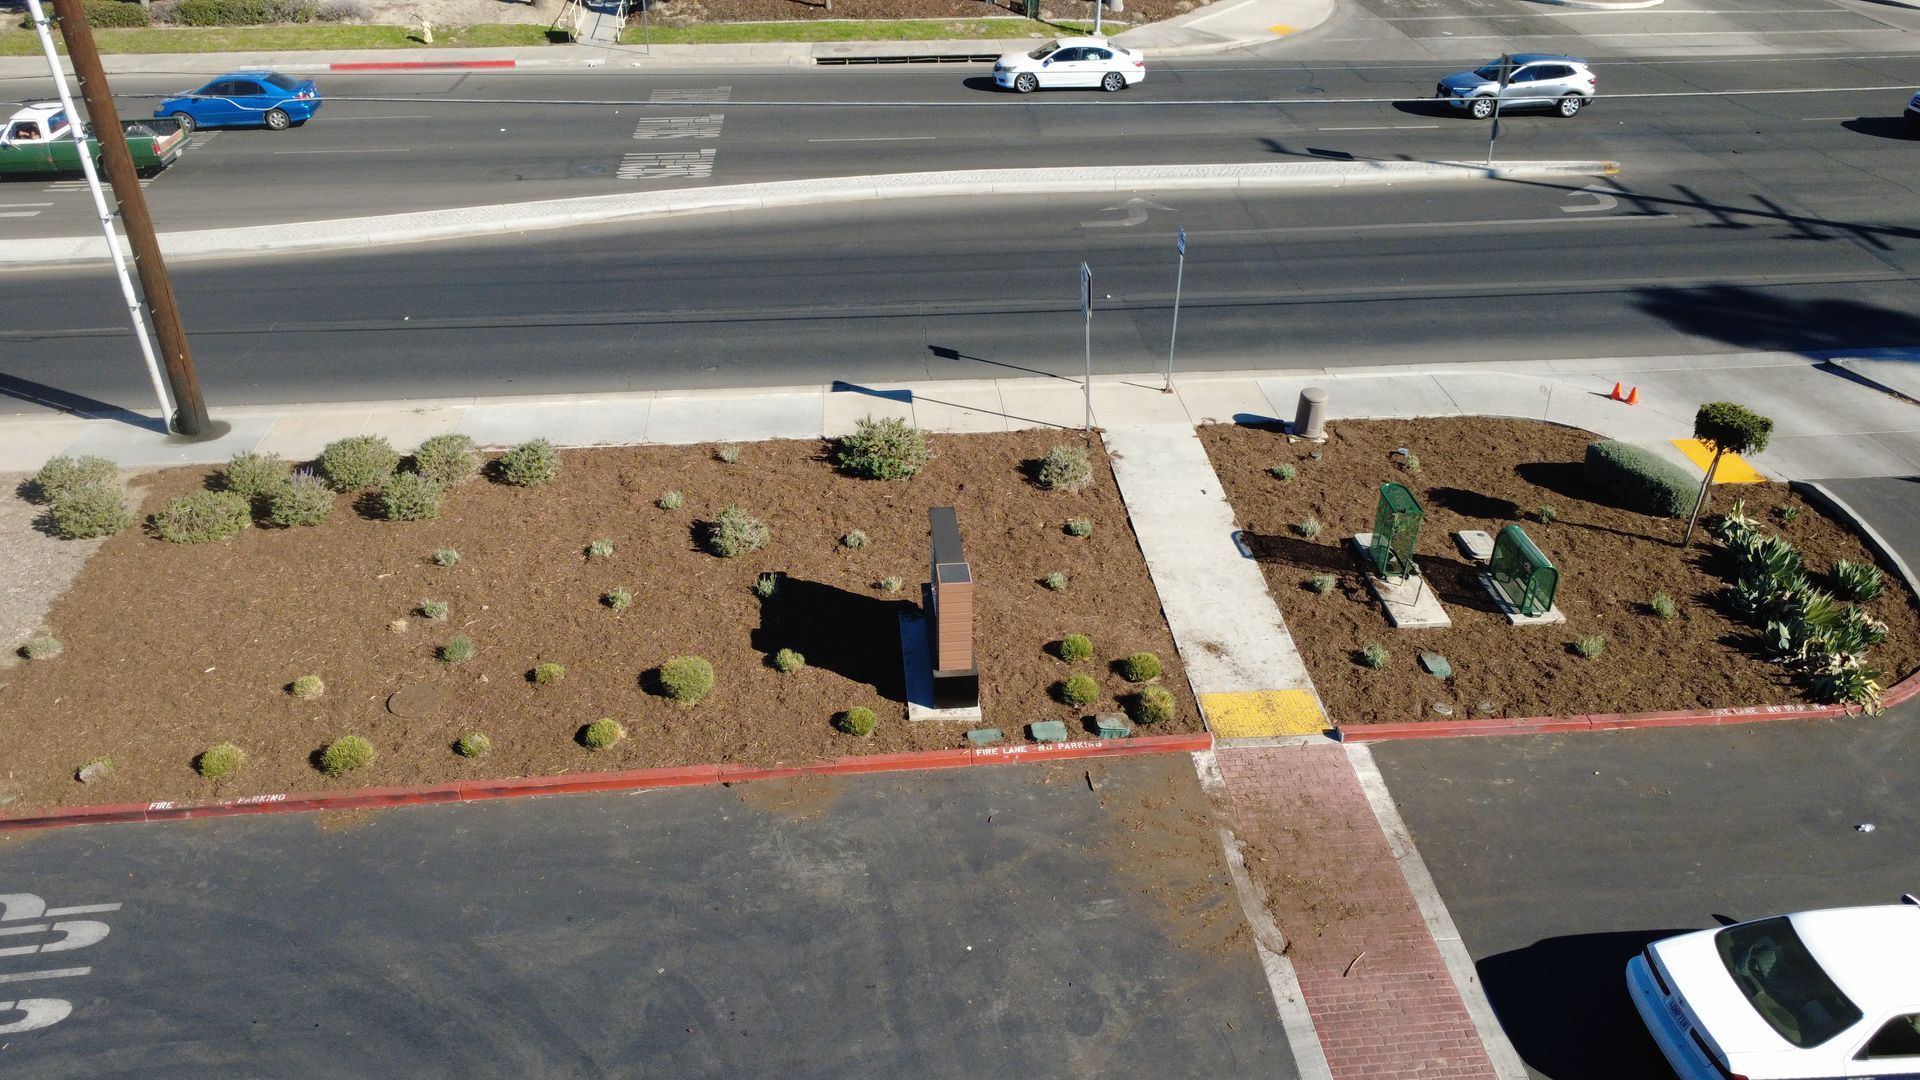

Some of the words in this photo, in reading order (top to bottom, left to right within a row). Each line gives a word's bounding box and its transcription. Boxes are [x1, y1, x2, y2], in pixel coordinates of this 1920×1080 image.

[616, 148, 717, 180] SIGNAL
[1785, 703, 1828, 712] PARNG
[976, 748, 998, 757] FIRE
[1003, 745, 1028, 754] LANE
[1038, 743, 1053, 752] NO
[1058, 741, 1102, 750] PARKING
[149, 801, 175, 811] FIRE
[237, 794, 286, 805] PARKING
